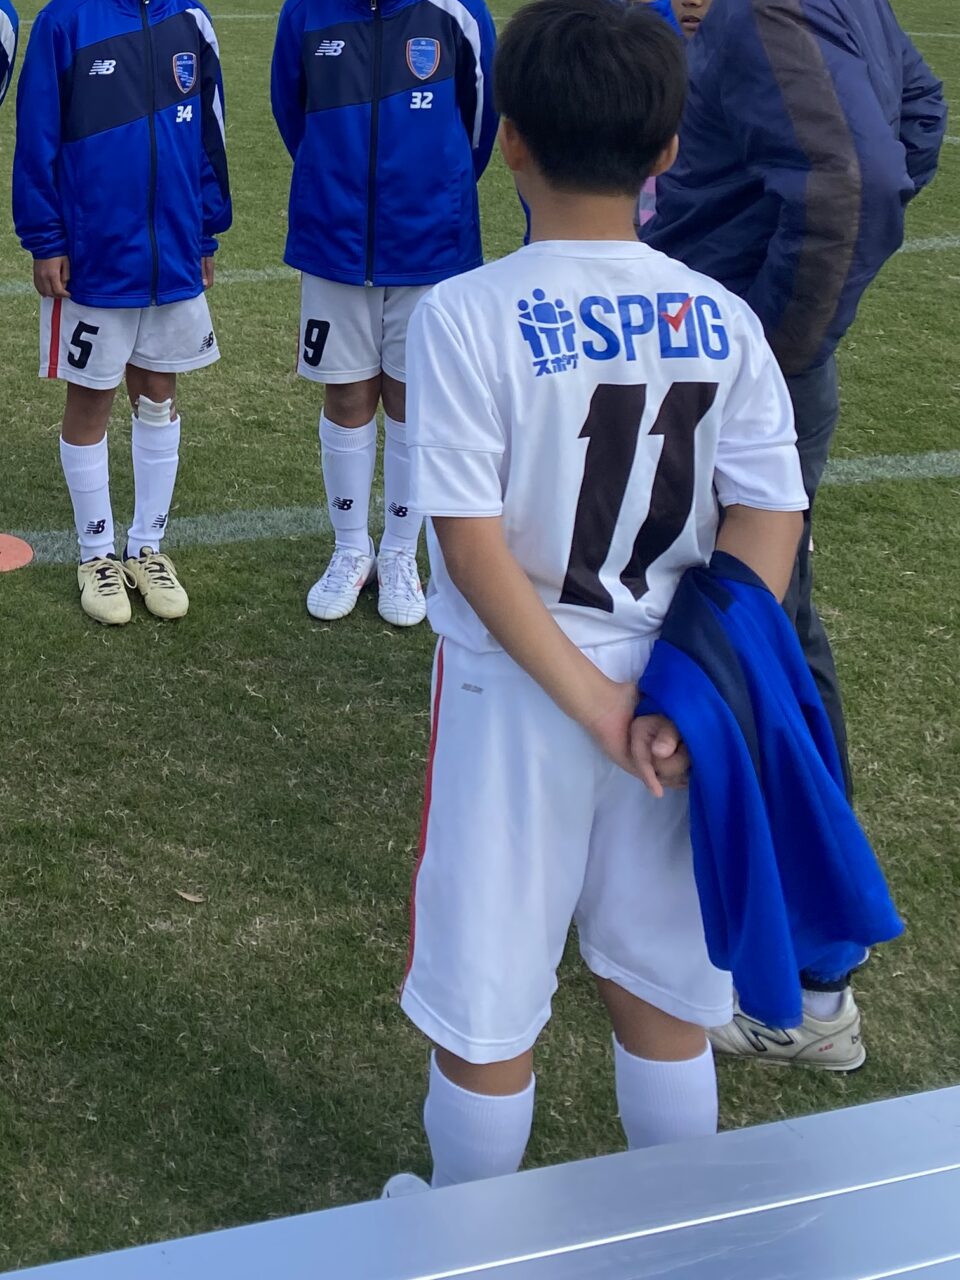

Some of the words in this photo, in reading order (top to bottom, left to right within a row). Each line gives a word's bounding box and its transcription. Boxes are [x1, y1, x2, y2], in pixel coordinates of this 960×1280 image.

[176, 105, 192, 122] 34
[410, 92, 433, 109] 32
[67, 320, 100, 369] 5
[303, 319, 330, 367] 9
[578, 292, 730, 361] SPOG
[533, 353, 579, 377] スポグ
[559, 382, 720, 613] 11
